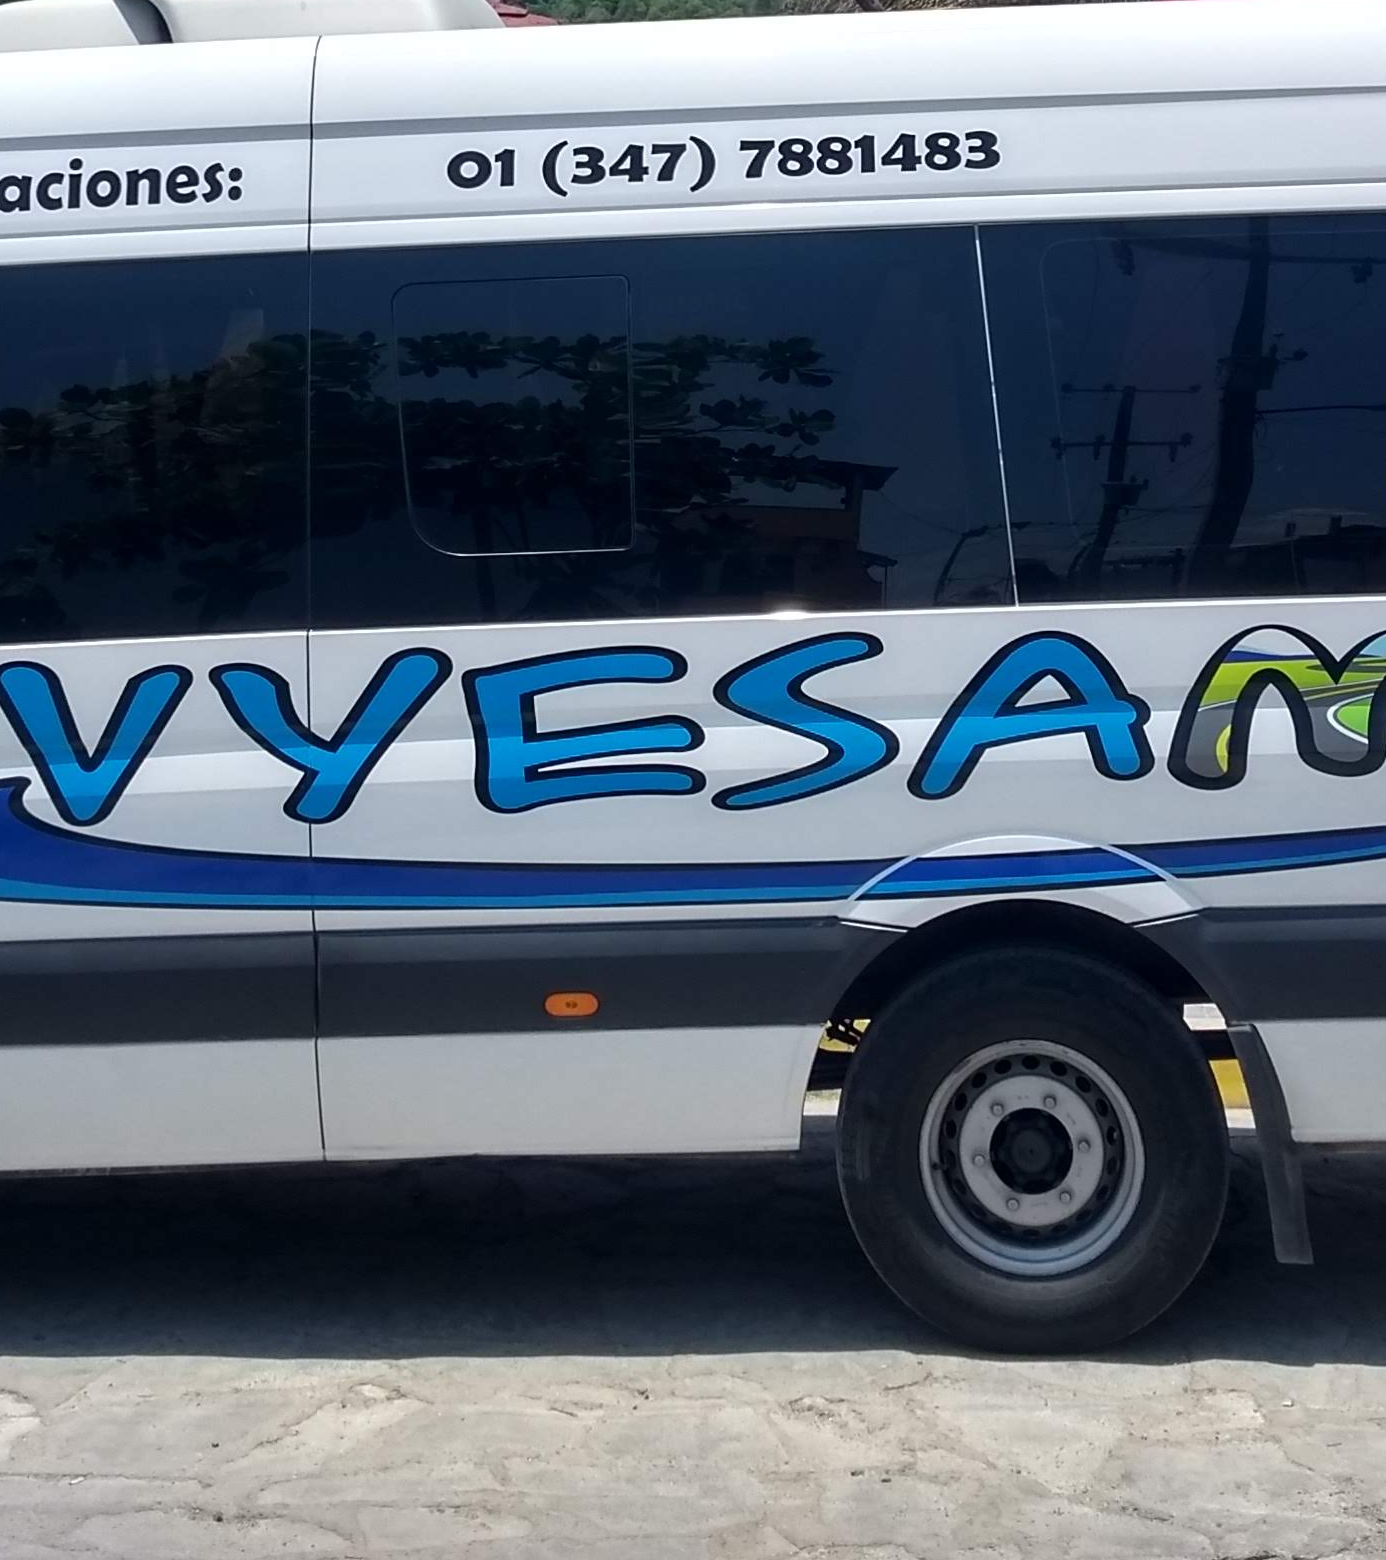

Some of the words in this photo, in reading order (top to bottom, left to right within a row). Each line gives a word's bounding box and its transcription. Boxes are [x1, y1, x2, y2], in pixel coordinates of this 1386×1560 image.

[447, 148, 516, 189] 01
[542, 135, 716, 197] (347)
[739, 130, 1000, 179] 7881483
